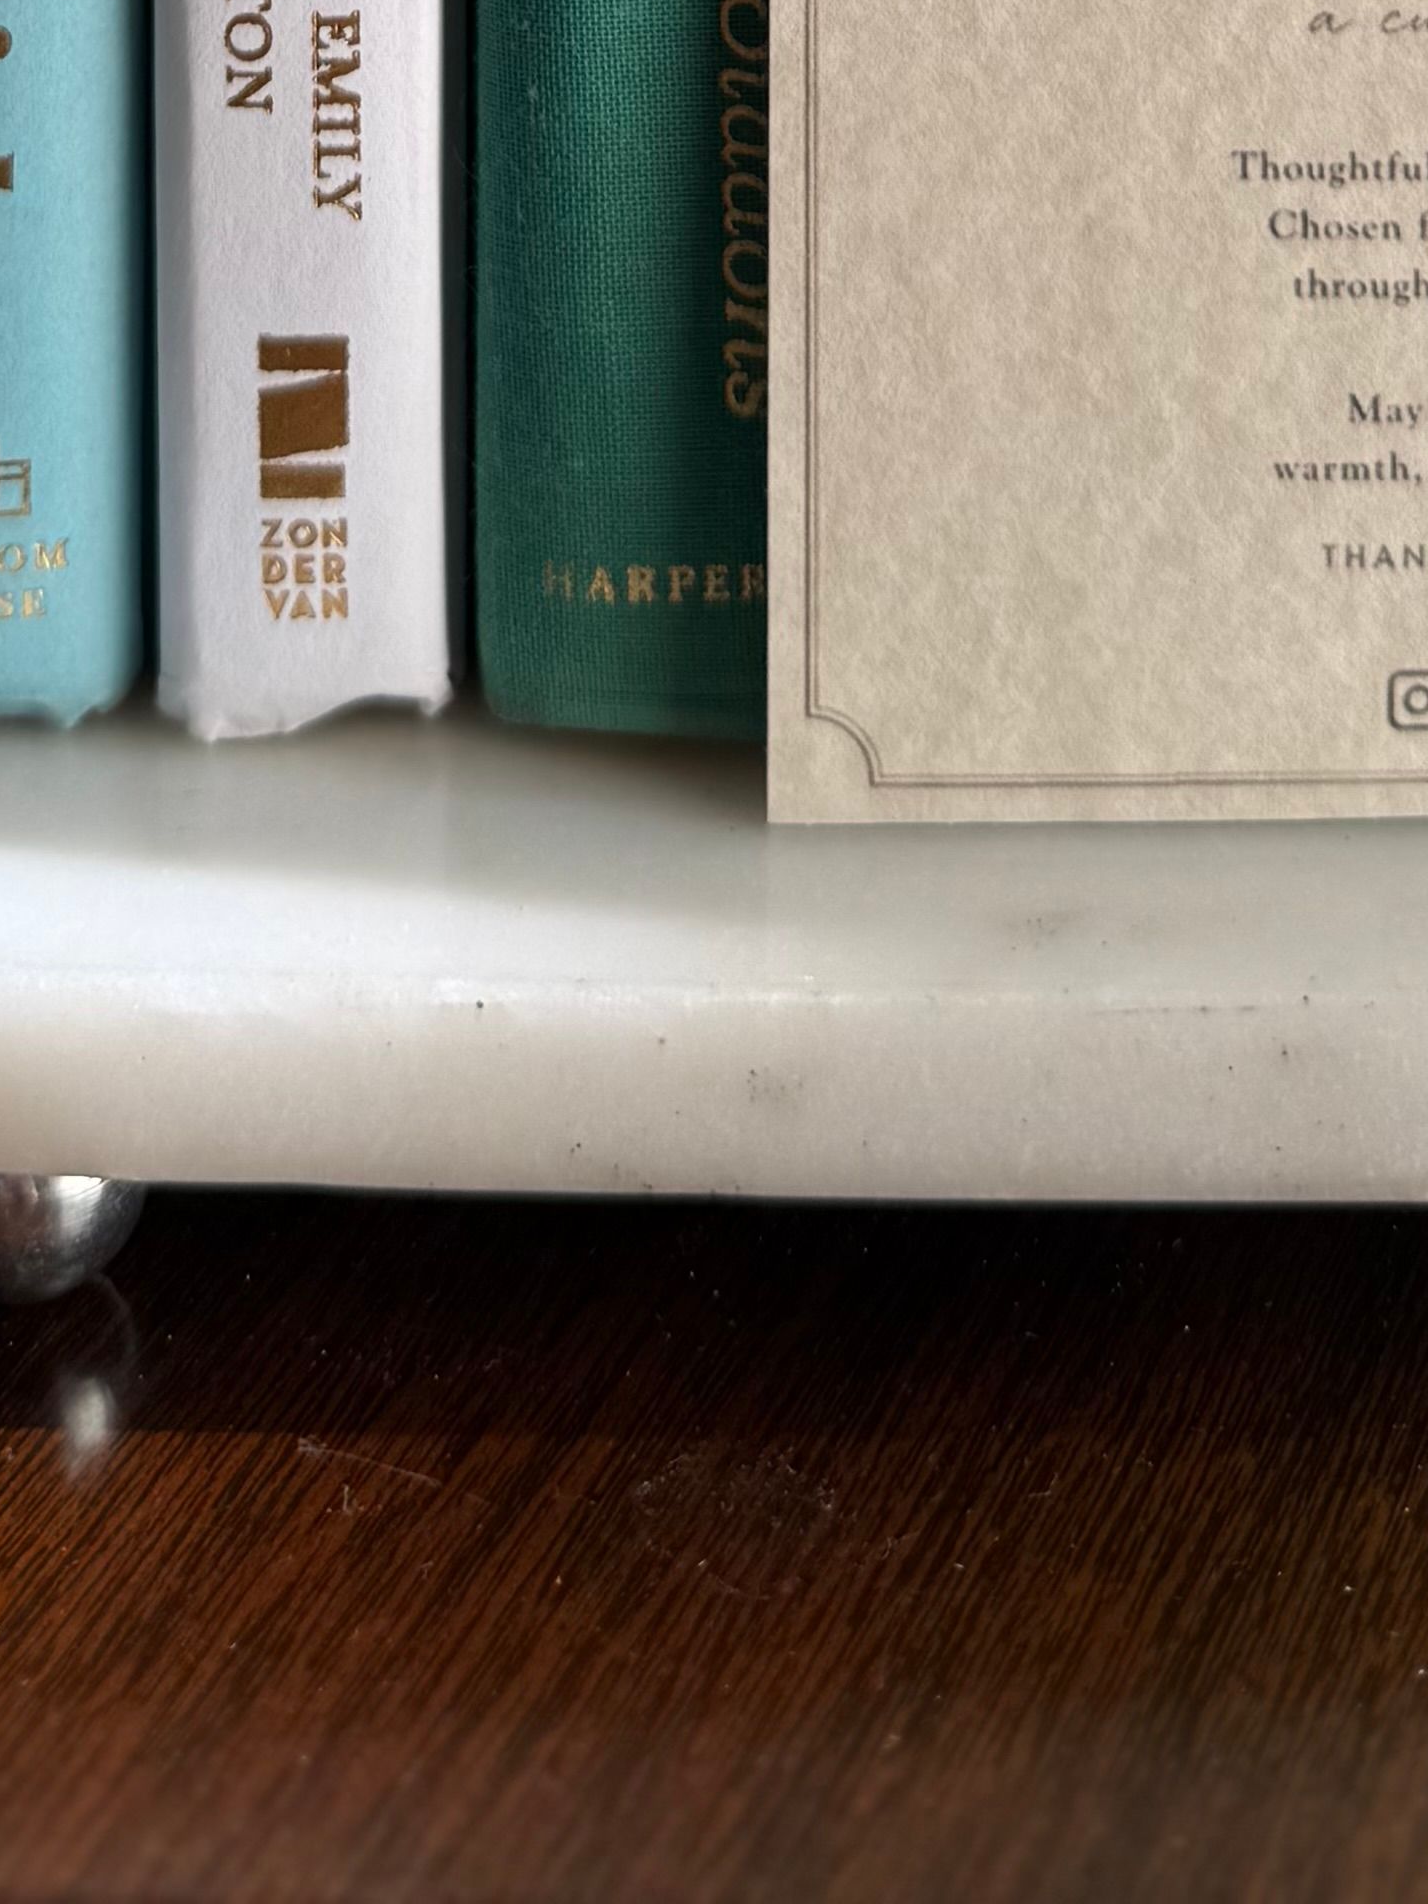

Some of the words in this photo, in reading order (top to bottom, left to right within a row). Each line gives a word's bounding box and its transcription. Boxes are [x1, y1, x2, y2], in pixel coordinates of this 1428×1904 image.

[1307, 11, 1353, 36] a
[311, 10, 363, 221] EMILY
[1268, 208, 1402, 242] Chosen
[1349, 393, 1423, 429] May
[1273, 451, 1423, 487] warmth,
[259, 516, 349, 549] ZON
[260, 553, 347, 585] DER
[263, 588, 349, 621] VAN
